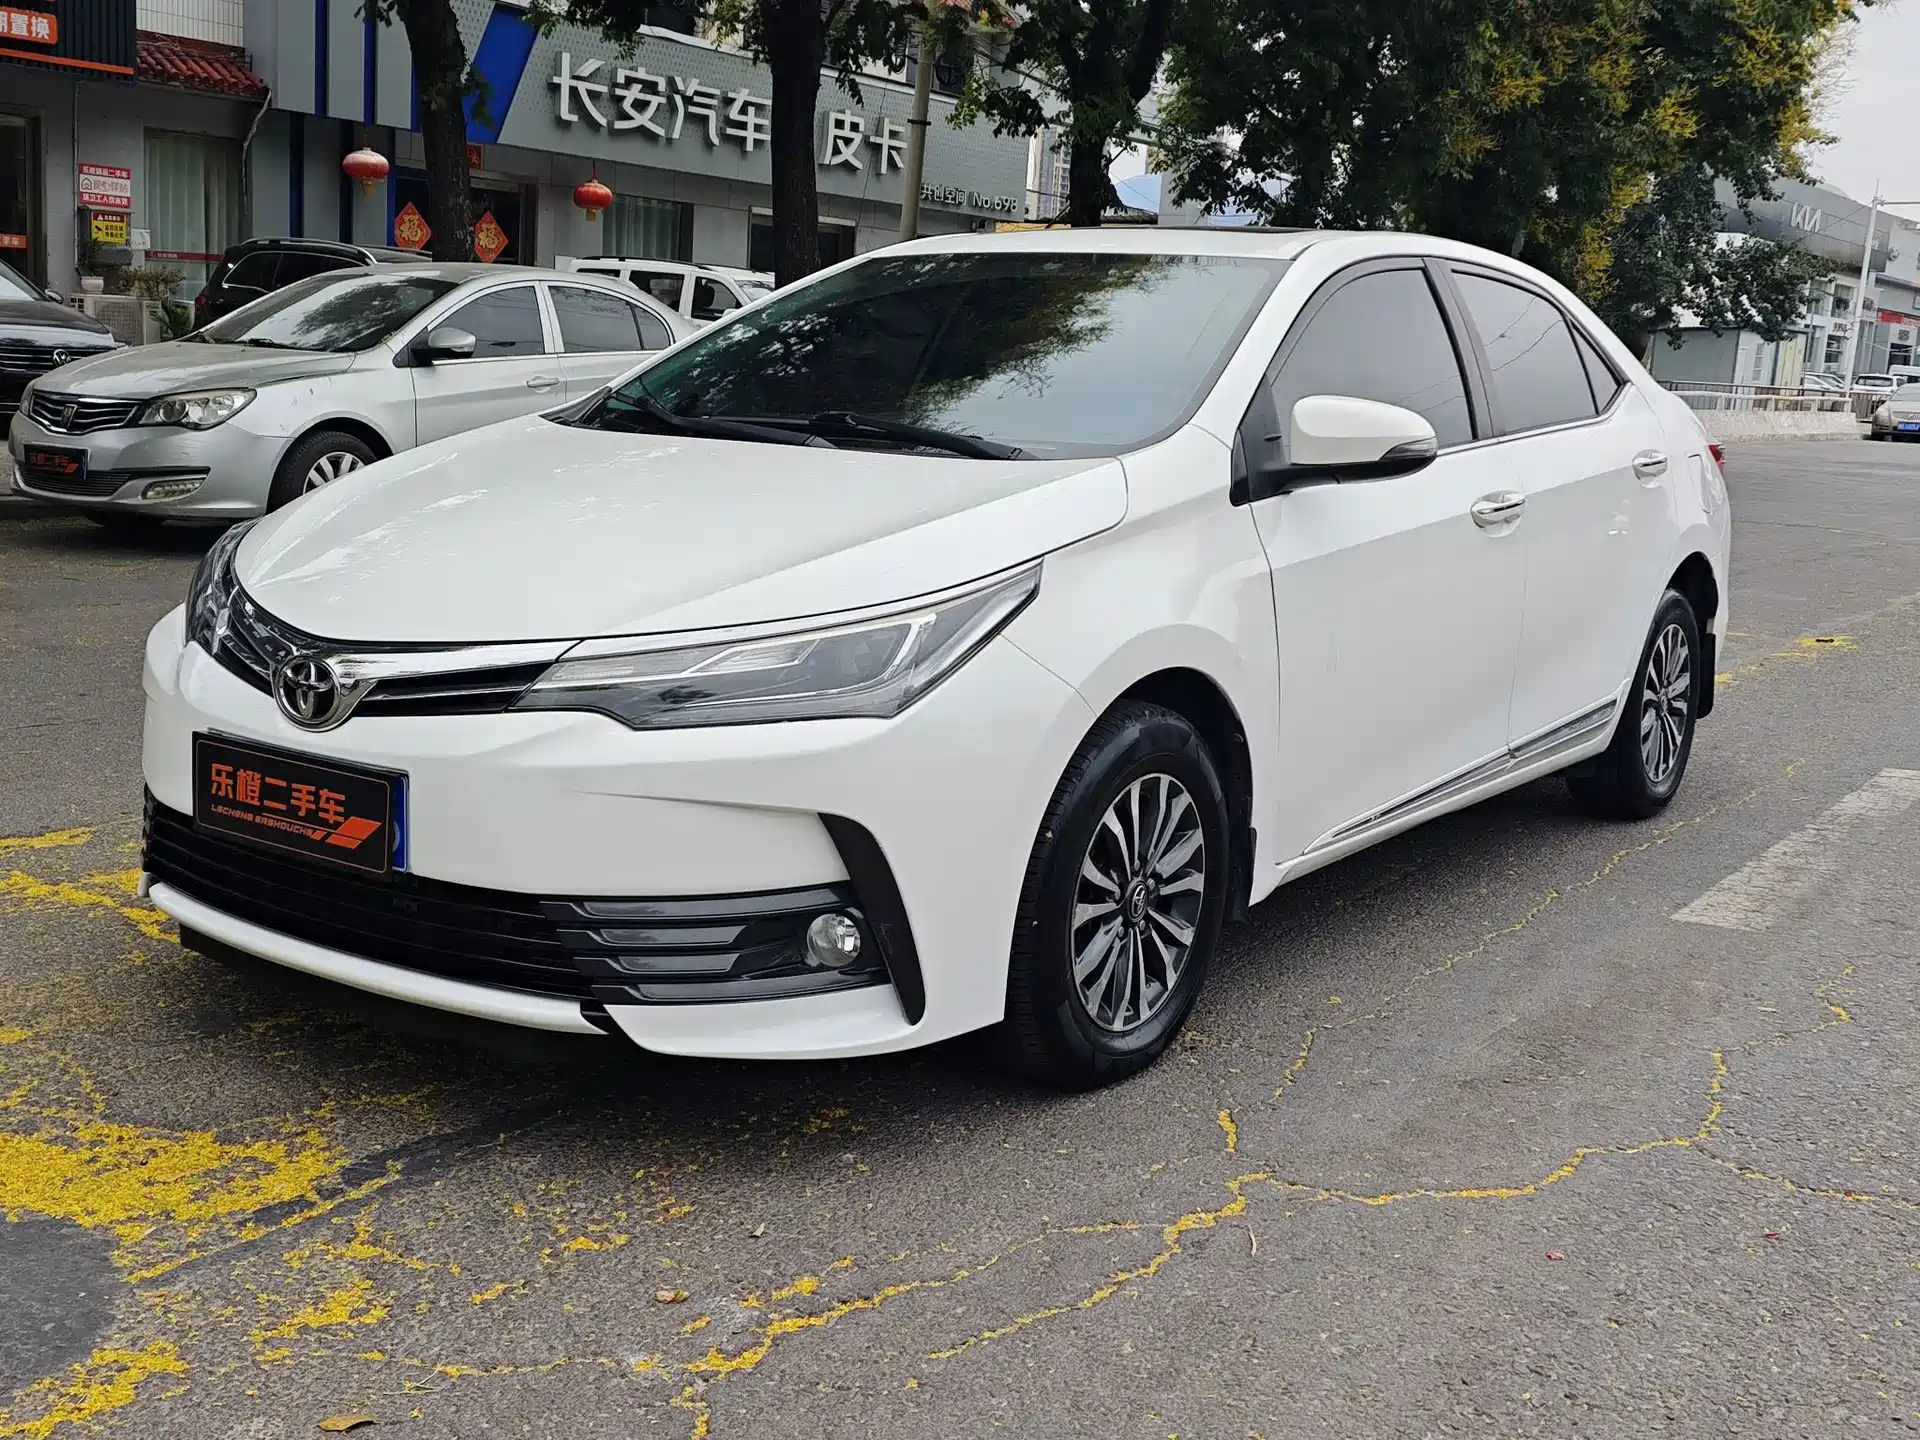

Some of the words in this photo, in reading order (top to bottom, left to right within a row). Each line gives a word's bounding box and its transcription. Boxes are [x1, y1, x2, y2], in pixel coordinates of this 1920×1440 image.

[552, 51, 772, 152] 长安汽车
[823, 109, 908, 174] 皮卡
[920, 182, 967, 204] 共创空间
[972, 192, 1018, 212] No.698
[210, 763, 346, 825] 乐橙二手车
